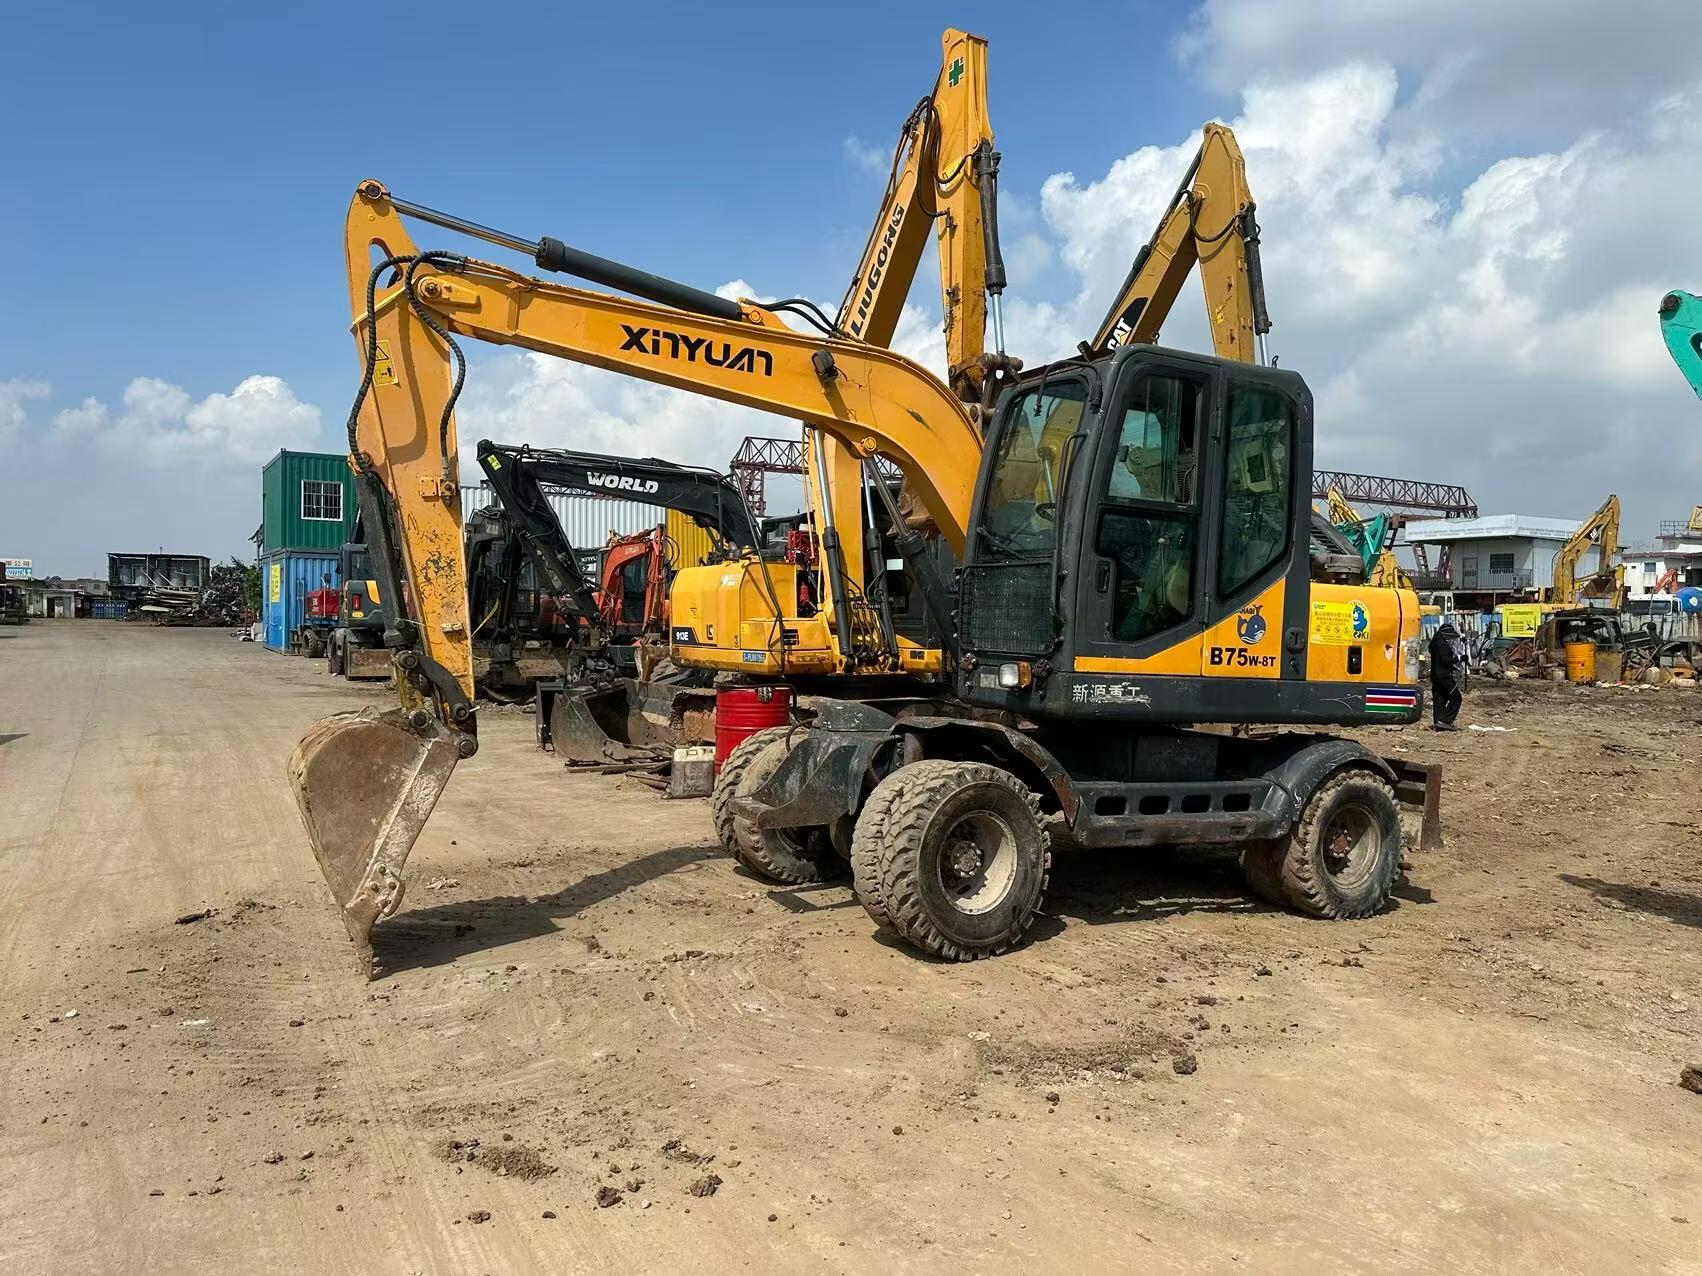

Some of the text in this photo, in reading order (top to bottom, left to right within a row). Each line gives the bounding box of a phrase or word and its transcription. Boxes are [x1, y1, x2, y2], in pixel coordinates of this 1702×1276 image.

[850, 203, 905, 337] LIUGONG
[1107, 317, 1133, 350] CAT
[619, 324, 773, 377] XINYUAN
[586, 471, 660, 494] WORLD
[1072, 683, 1141, 704] 新源重工
